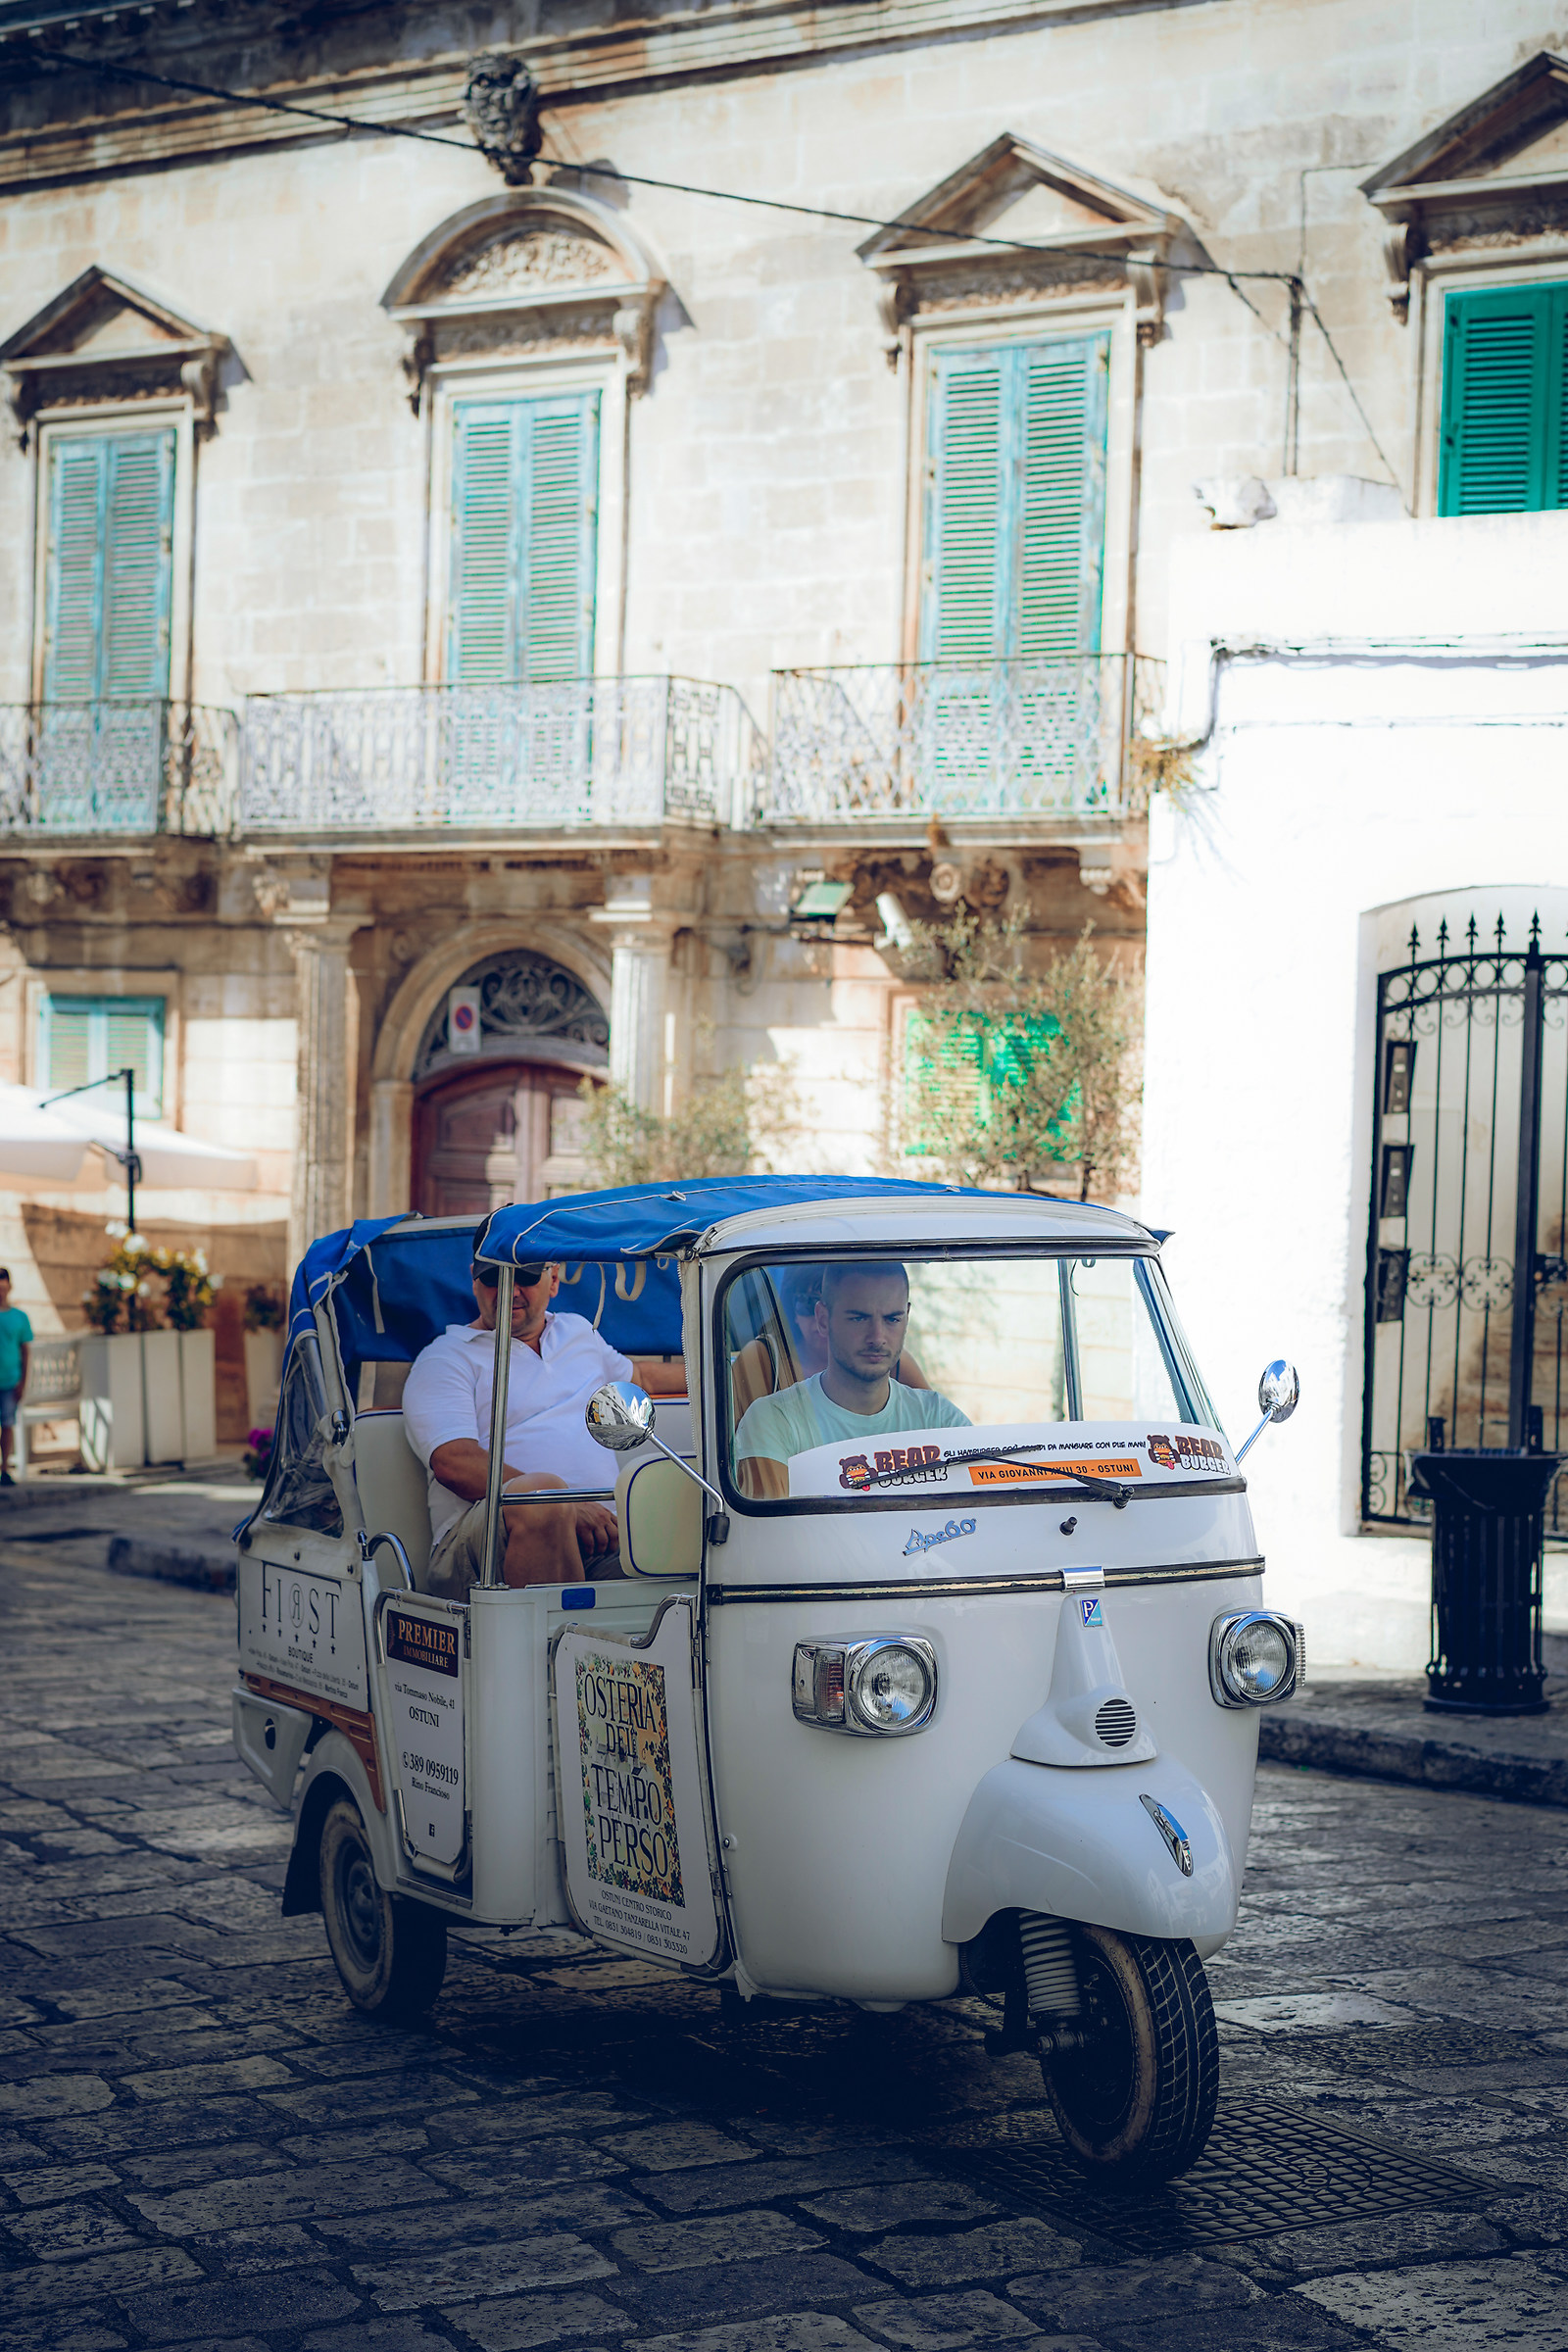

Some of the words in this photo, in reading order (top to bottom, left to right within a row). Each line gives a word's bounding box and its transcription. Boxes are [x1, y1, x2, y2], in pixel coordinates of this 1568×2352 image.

[1059, 1442, 1094, 1450] MANGIARE
[1175, 1436, 1224, 1459] BEAR
[978, 1469, 996, 1480] VIA
[1076, 1465, 1088, 1474] 30
[1098, 1464, 1135, 1473] OSTUNI
[1180, 1454, 1231, 1475] BURGER
[398, 1619, 456, 1654] PREMIER
[404, 1645, 449, 1668] IMMOBILIARE
[403, 1684, 427, 1701] Tommaso
[449, 1699, 455, 1709] 41
[584, 1674, 657, 1733] OSTERIA
[409, 1705, 439, 1727] OSTUNI
[606, 1722, 637, 1757] DEL
[410, 1753, 423, 1773] 389
[426, 1759, 459, 1786] 0959119
[412, 1777, 423, 1790] Rino
[591, 1764, 662, 1826] TEMPO
[598, 1814, 668, 1878] PERSO
[588, 1899, 597, 1911] VIA
[598, 1902, 623, 1920] GAETANO
[623, 1912, 660, 1932] TANZARELLA
[661, 1924, 681, 1938] VITALE
[682, 1931, 690, 1940] 47
[602, 1889, 620, 1904] OSTUNI
[621, 1896, 645, 1912] CENTRO
[646, 1904, 672, 1921] STORICO
[606, 1920, 618, 1933] 0831
[620, 1925, 642, 1939] 304819
[647, 1934, 662, 1946] 0831
[663, 1938, 688, 1954] 303320
